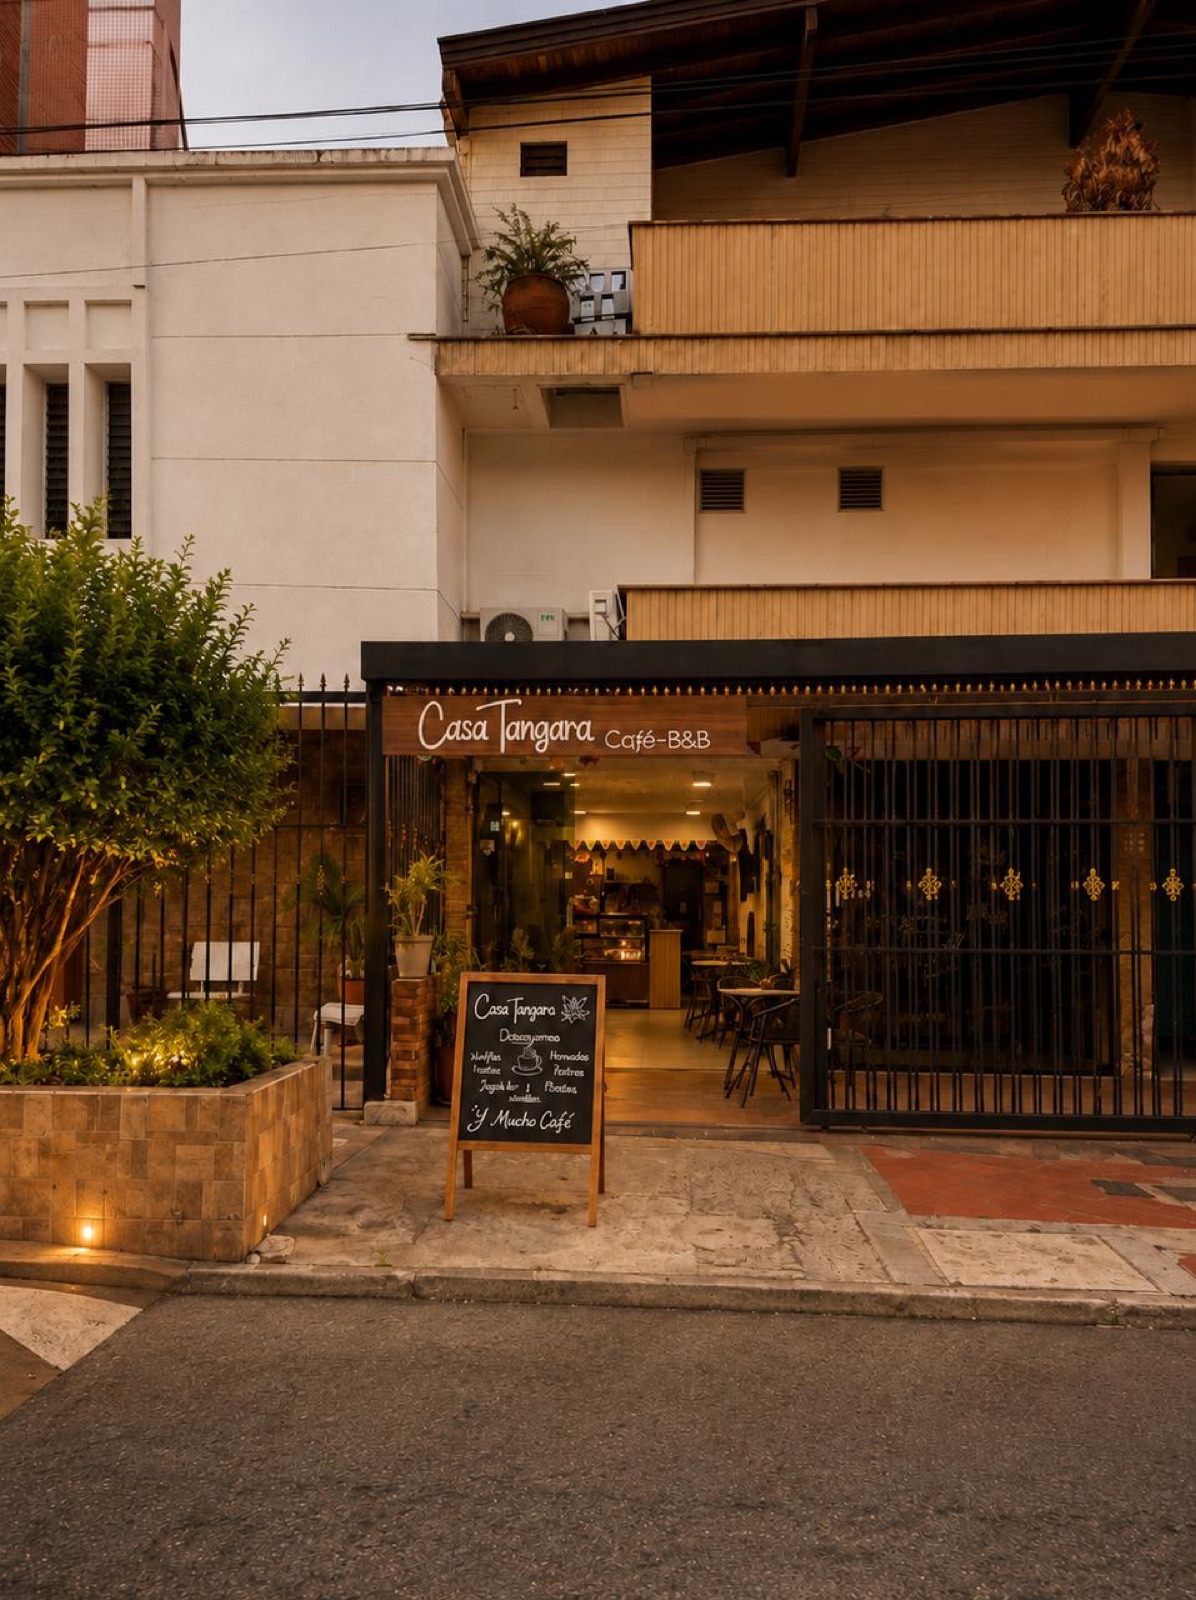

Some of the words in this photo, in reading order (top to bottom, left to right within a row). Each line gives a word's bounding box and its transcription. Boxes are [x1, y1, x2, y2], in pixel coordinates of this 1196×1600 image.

[418, 700, 488, 750] Casa
[476, 698, 595, 754] Tangara
[474, 993, 509, 1020] Casa
[507, 996, 556, 1024] Tangara
[490, 1109, 537, 1129] Mucho
[539, 1110, 575, 1134] Café
